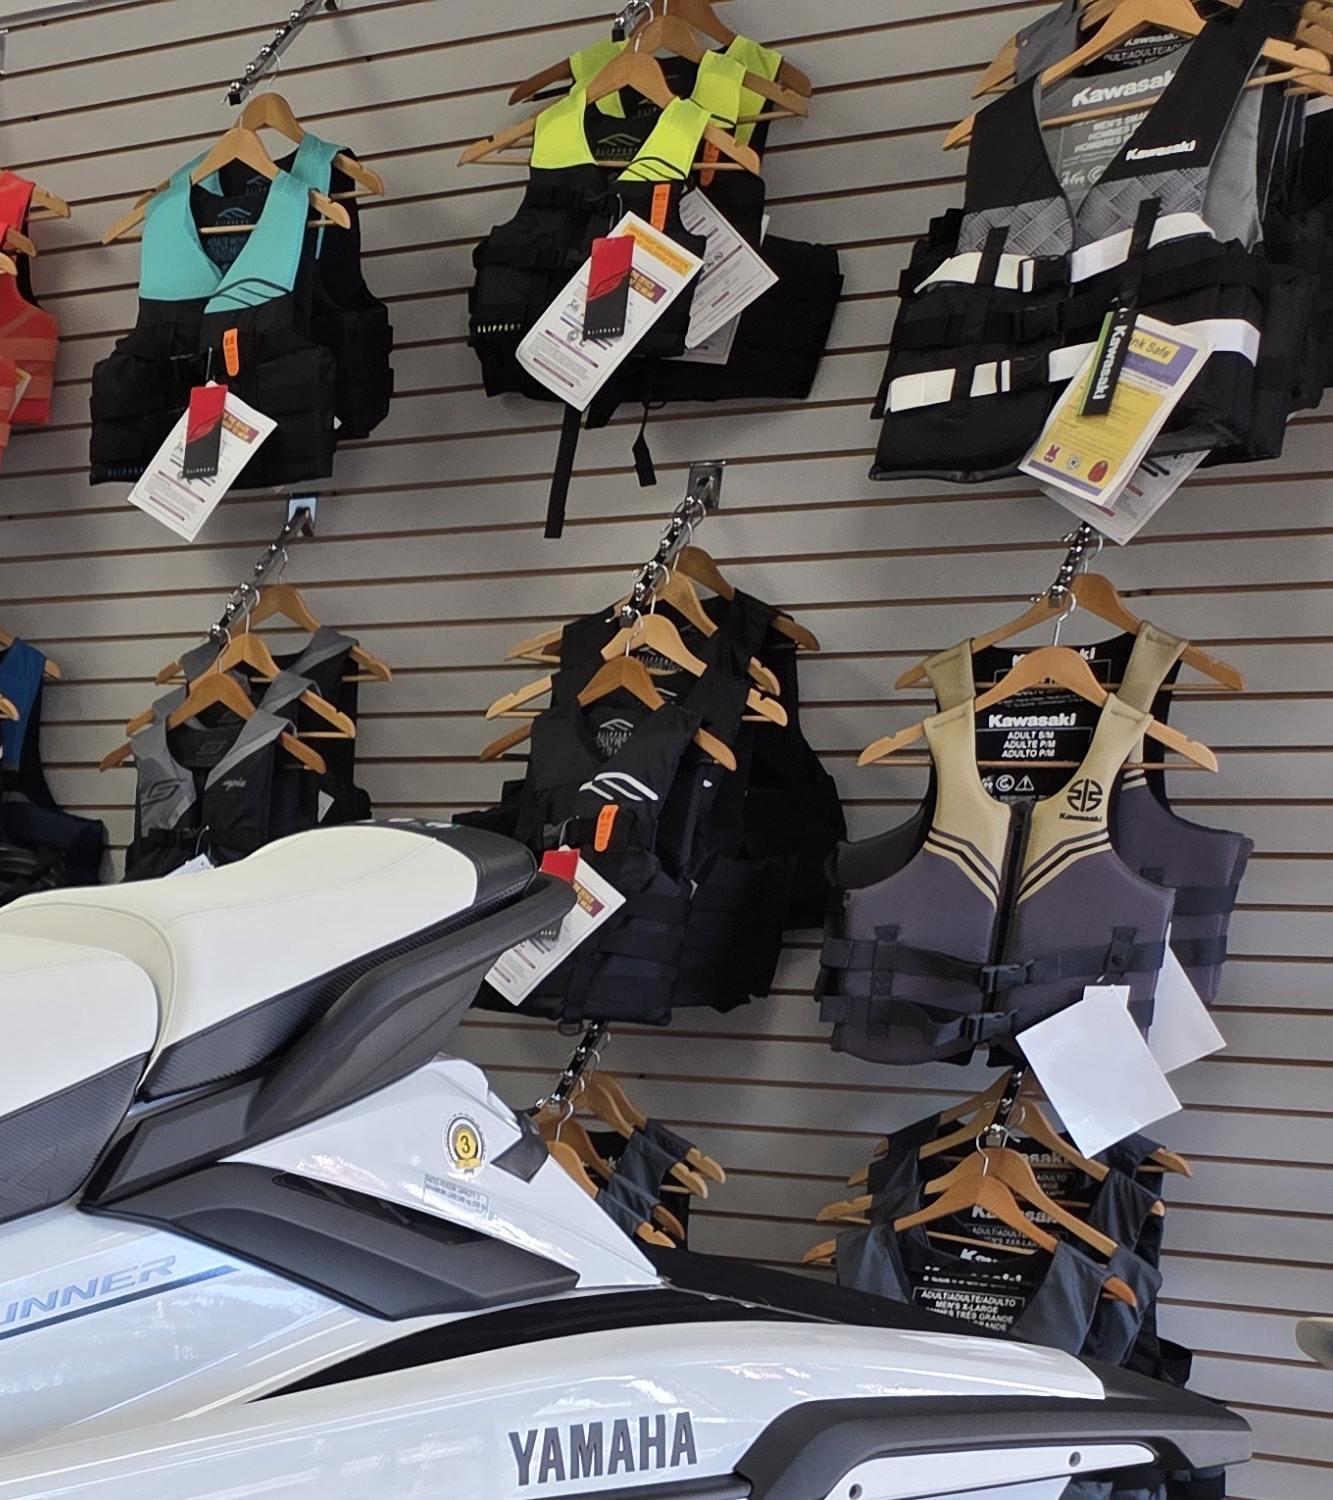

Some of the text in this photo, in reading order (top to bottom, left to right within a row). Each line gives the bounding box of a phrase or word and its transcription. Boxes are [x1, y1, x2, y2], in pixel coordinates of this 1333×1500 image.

[1072, 70, 1176, 107] Kawasak
[1125, 140, 1196, 161] Kawasaki
[1147, 341, 1171, 359] Safe
[1092, 324, 1129, 401] Kawasaki
[988, 712, 1077, 728] Kawasaki
[1007, 731, 1036, 740] ADULT
[1003, 740, 1038, 749] ADULTE
[1001, 749, 1038, 758] ADULTO
[1059, 812, 1102, 823] Kawasaki
[460, 1135, 470, 1154] 3
[978, 1311, 1014, 1324] GRANDE
[508, 1411, 697, 1487] YAMAHA
